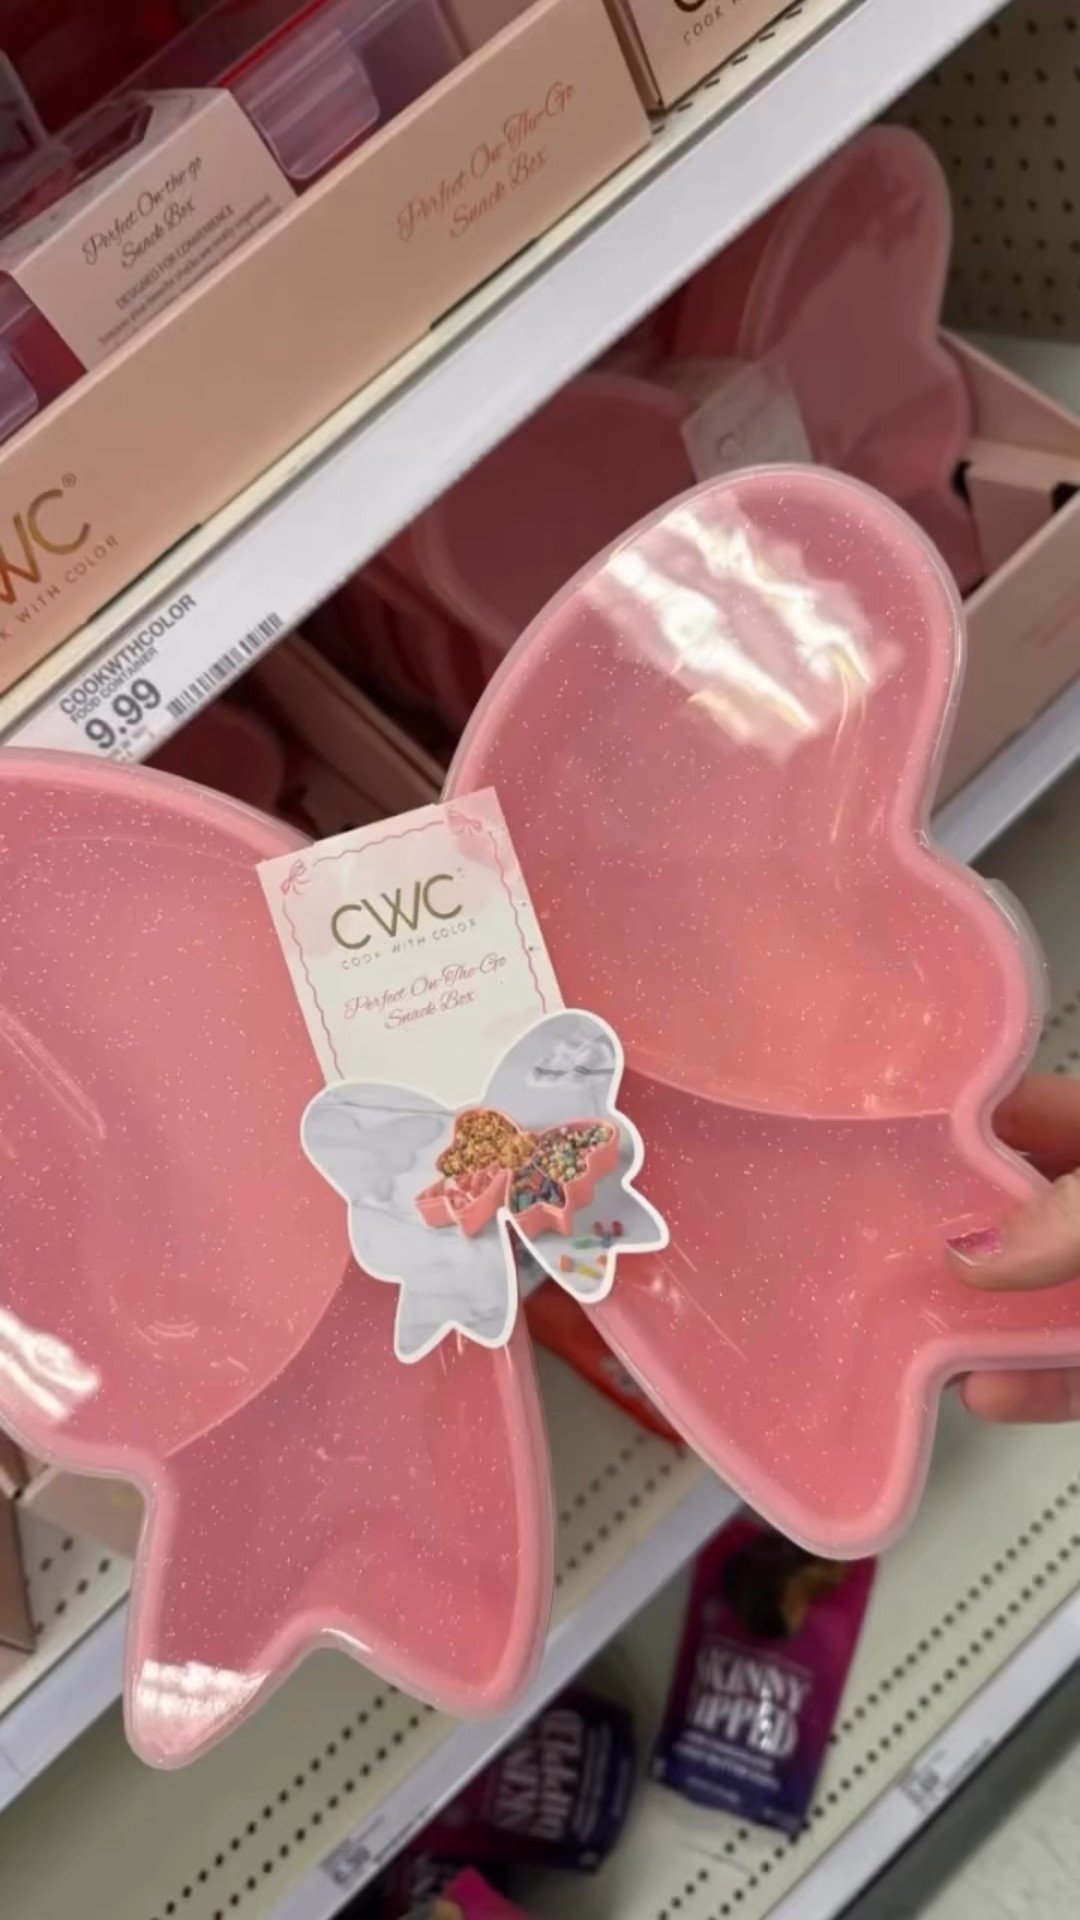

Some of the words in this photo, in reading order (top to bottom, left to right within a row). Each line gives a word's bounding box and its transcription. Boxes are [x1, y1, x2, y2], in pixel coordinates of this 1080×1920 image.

[683, 5, 722, 45] COOK
[397, 171, 465, 242] Perfect
[470, 81, 575, 179] On-The-Go
[450, 181, 505, 239] Snack
[507, 146, 547, 189] Box
[82, 208, 139, 267] Perfect
[121, 222, 165, 268] Snack
[163, 196, 196, 230] Box
[115, 265, 159, 310] DESIGNED
[158, 252, 176, 274] FOR
[15, 584, 62, 624] WITH
[64, 535, 119, 584] COLOR
[60, 593, 197, 715] COOKWTHCOLOR
[70, 697, 101, 725] FOOD
[100, 647, 159, 699] CONTAINER
[84, 678, 162, 749] 9.99
[331, 873, 463, 950] CWC
[341, 952, 382, 970] COOK
[391, 935, 426, 954] WITH
[431, 918, 477, 941] COLOR
[344, 987, 407, 1020] Perfect
[410, 952, 507, 996] On-The-Go
[384, 1001, 438, 1030] Snack
[440, 988, 476, 1011] Box
